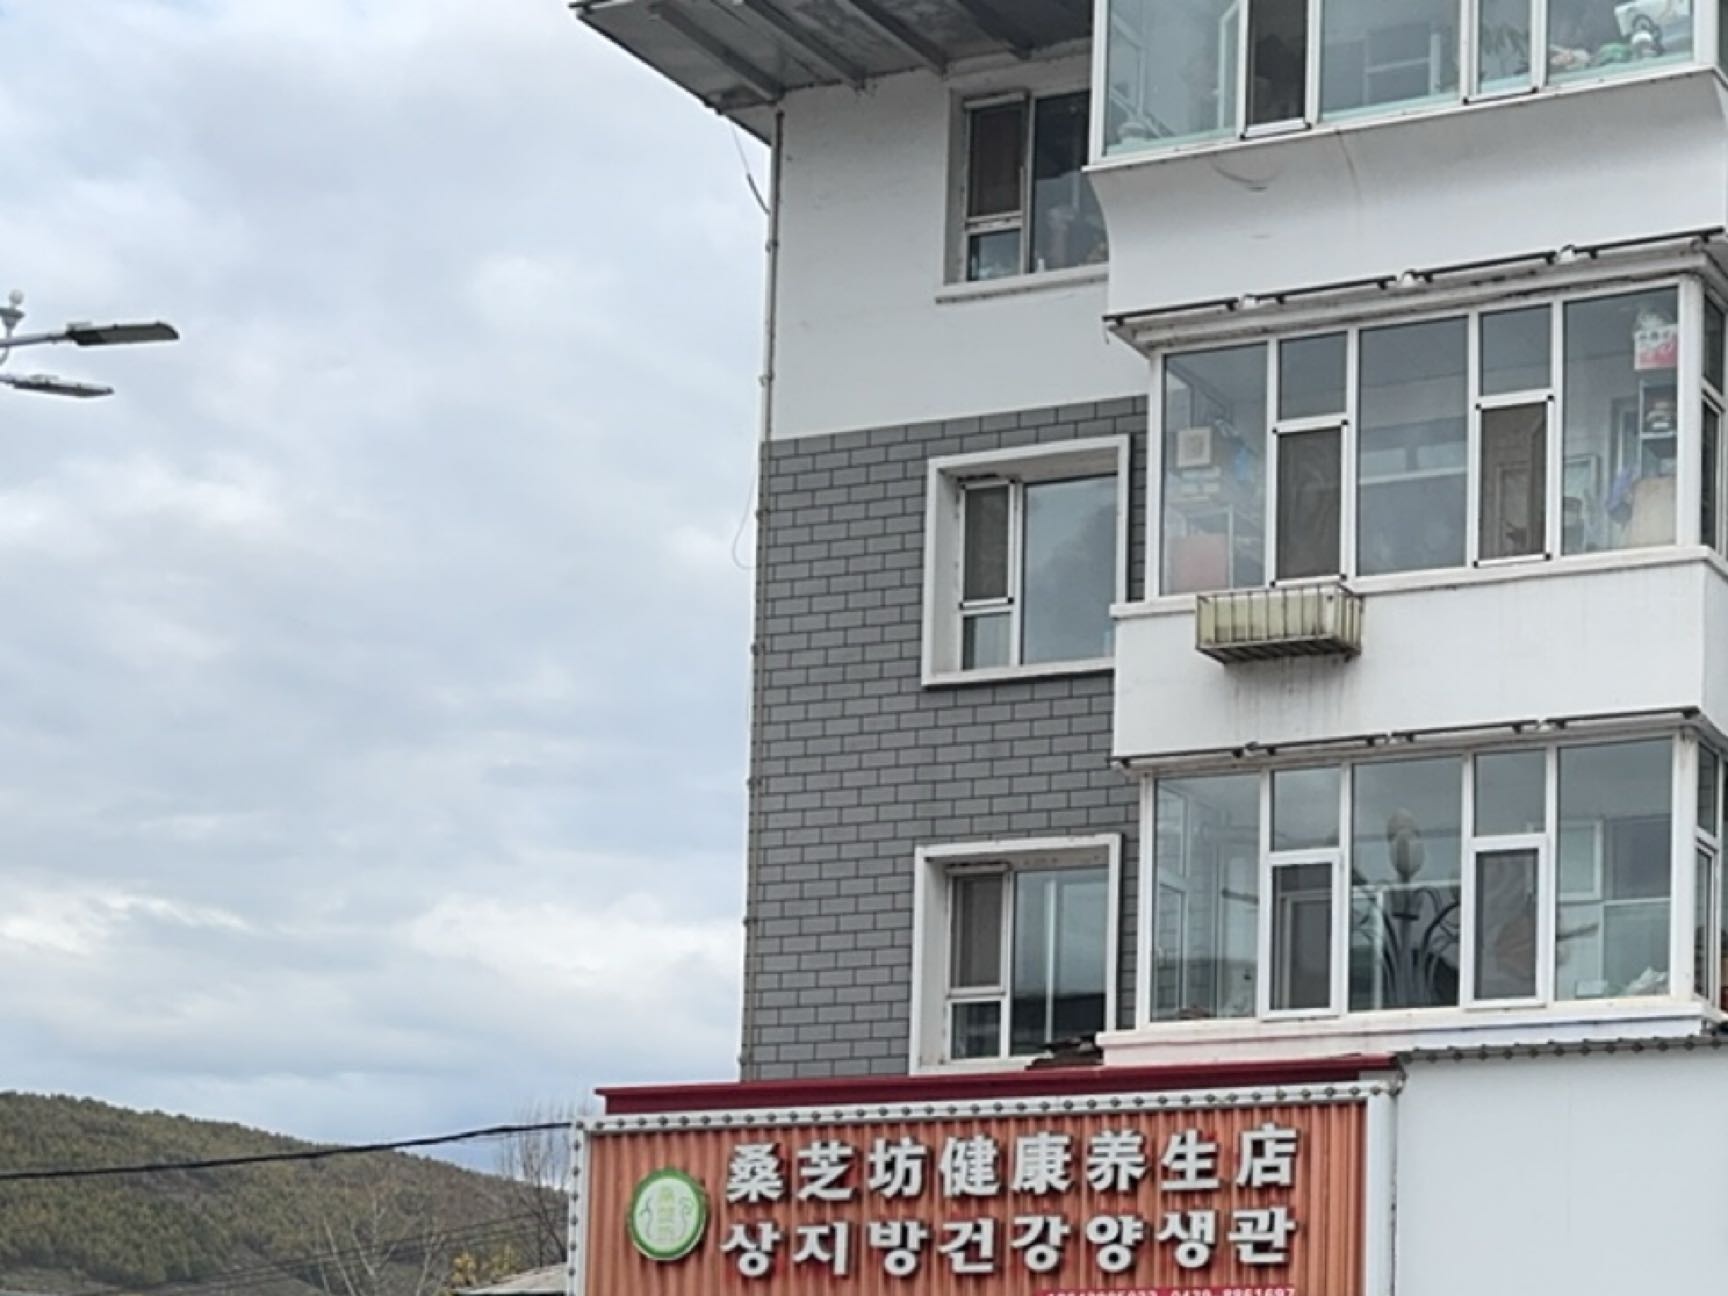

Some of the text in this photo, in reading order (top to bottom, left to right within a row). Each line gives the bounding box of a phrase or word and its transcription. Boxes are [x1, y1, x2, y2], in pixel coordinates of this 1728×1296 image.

[726, 1122, 1298, 1203] 桑芝坊健康养生店
[720, 1206, 1297, 1278] 상지방건강양생관
